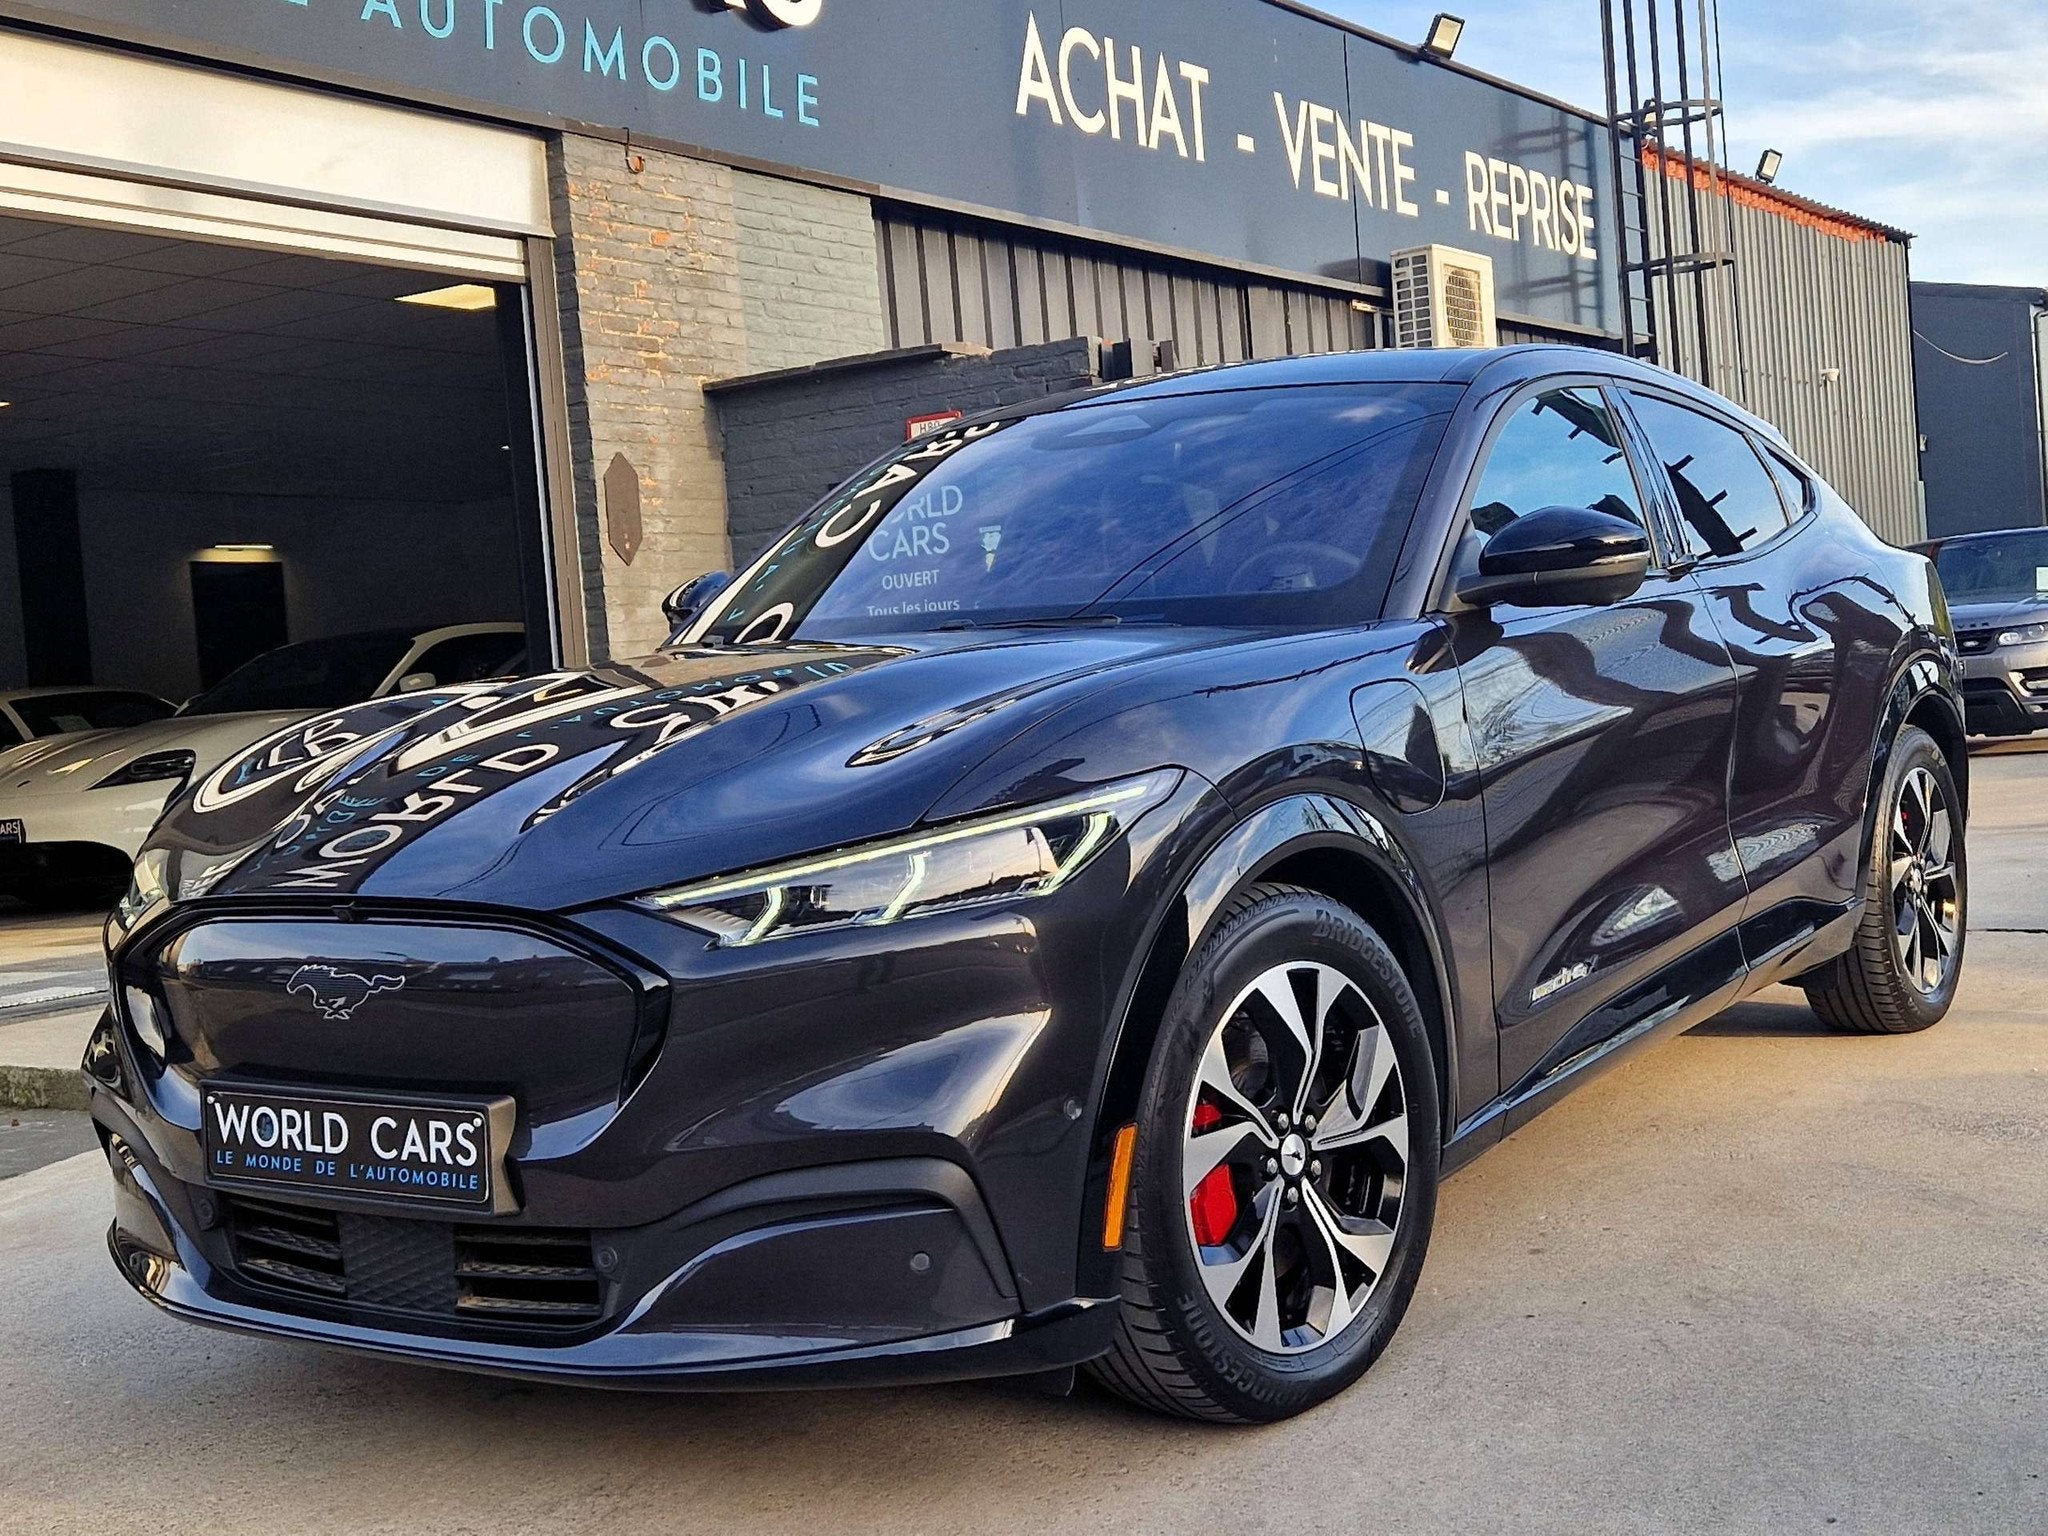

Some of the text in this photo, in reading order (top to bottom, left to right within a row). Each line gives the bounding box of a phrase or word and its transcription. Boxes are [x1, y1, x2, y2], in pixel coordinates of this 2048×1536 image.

[1015, 9, 1209, 161] ACHAT
[1273, 91, 1419, 217] VENTE
[1465, 150, 1598, 261] REPRISE
[867, 521, 951, 562] CARS
[882, 569, 940, 591] OUVERT
[902, 600, 921, 615] les
[0, 821, 18, 835] ARS
[214, 1102, 478, 1168] WORLD CARS
[216, 1150, 479, 1190] LE MONDE DE L'AUTOMOBILE
